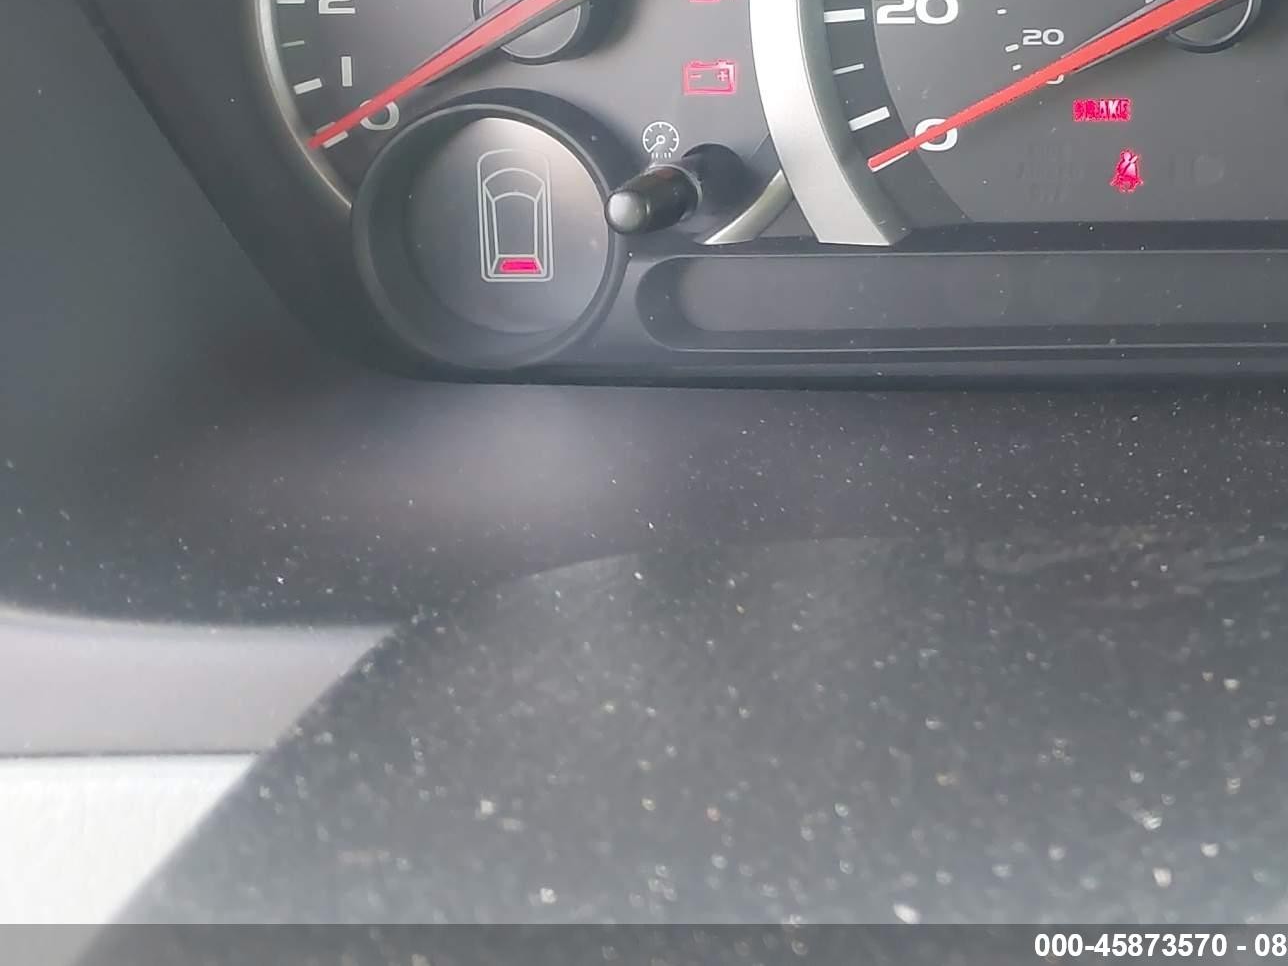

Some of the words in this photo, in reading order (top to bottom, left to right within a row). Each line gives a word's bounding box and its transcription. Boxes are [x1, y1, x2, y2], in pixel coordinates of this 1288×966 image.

[1022, 29, 1064, 46] 20
[341, 57, 353, 87] 1
[359, 98, 399, 130] 0
[915, 118, 958, 151] 0
